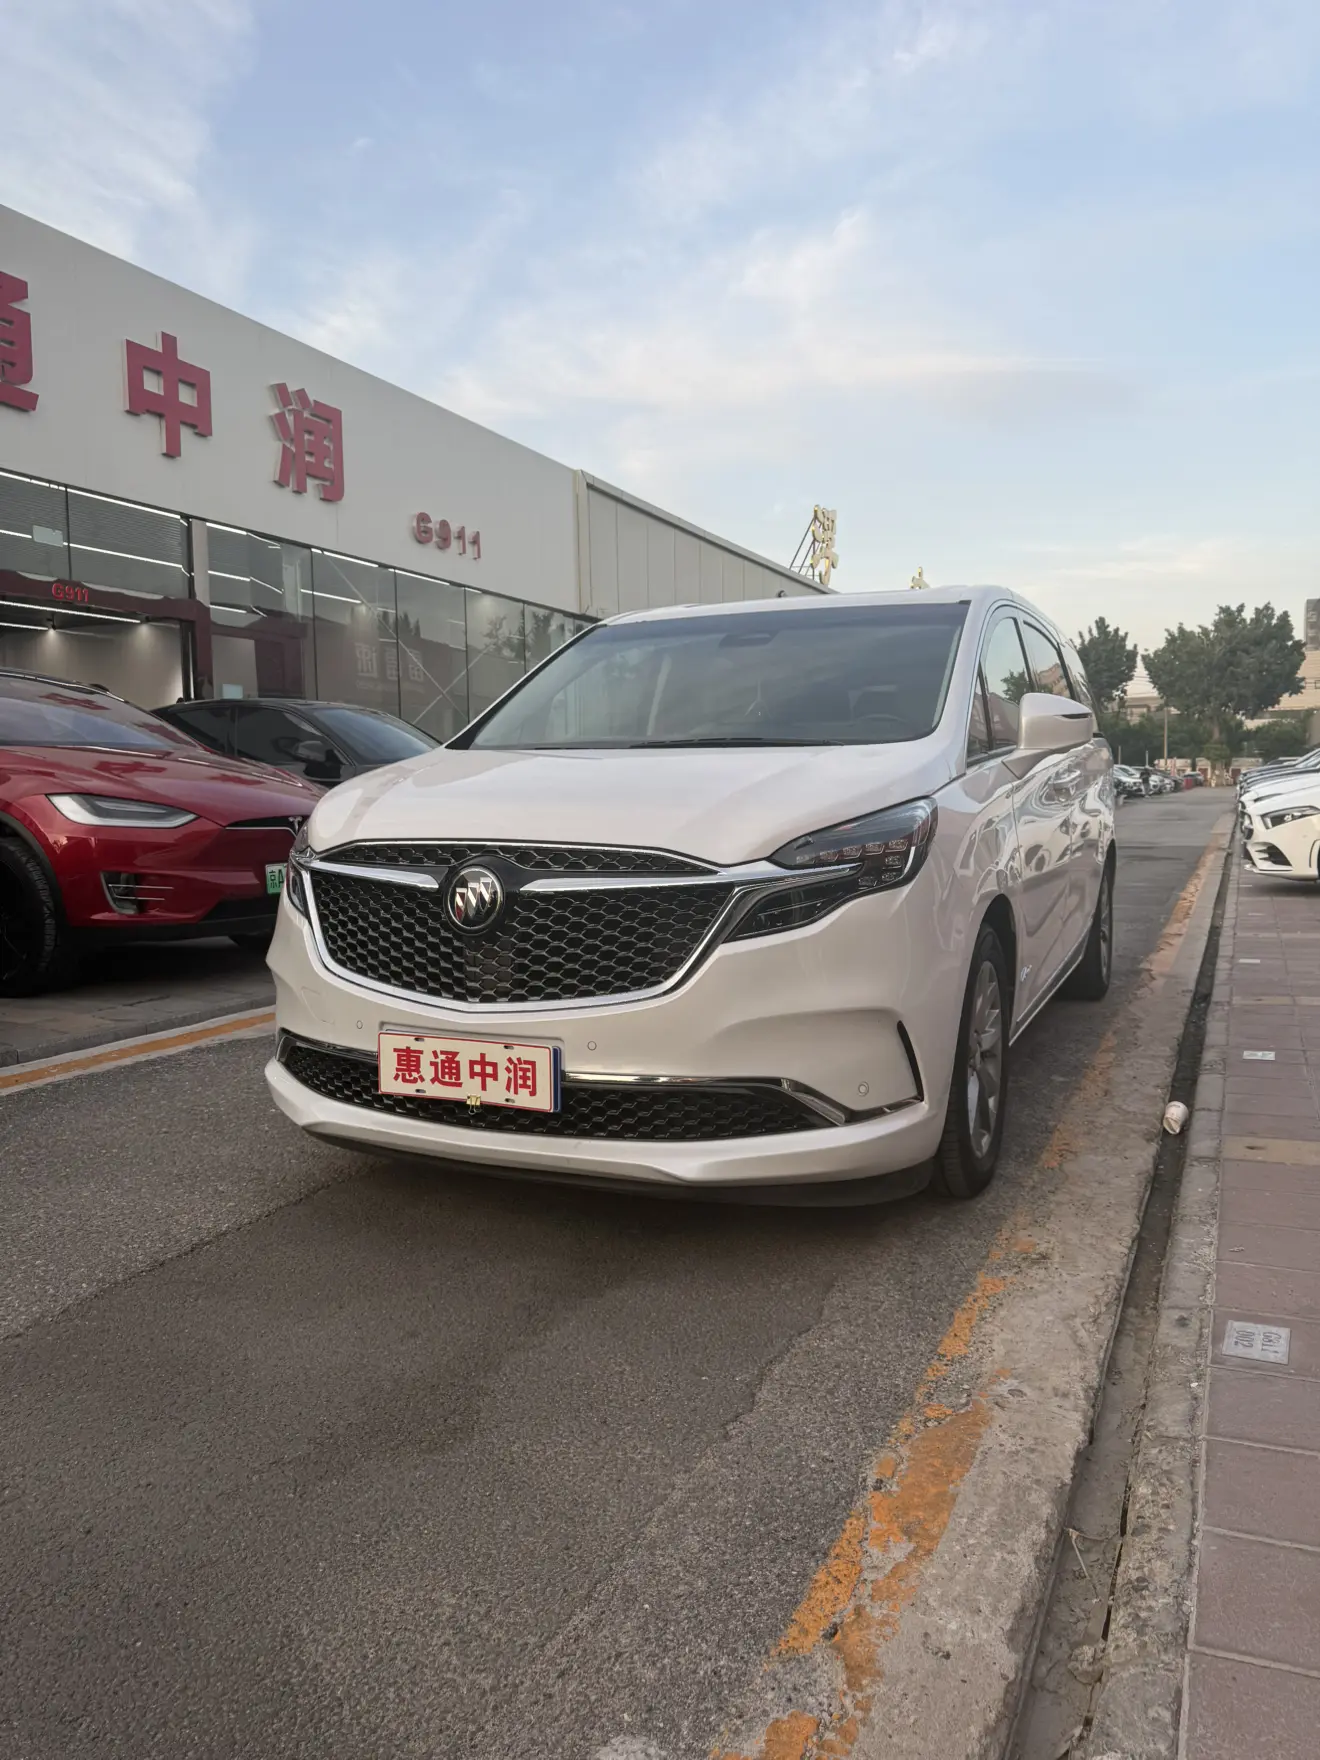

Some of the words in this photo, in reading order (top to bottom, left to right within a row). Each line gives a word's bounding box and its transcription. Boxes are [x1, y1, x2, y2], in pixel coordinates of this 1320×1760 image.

[413, 512, 481, 560] G911
[52, 583, 89, 603] G911
[392, 1046, 538, 1097] 惠通中润
